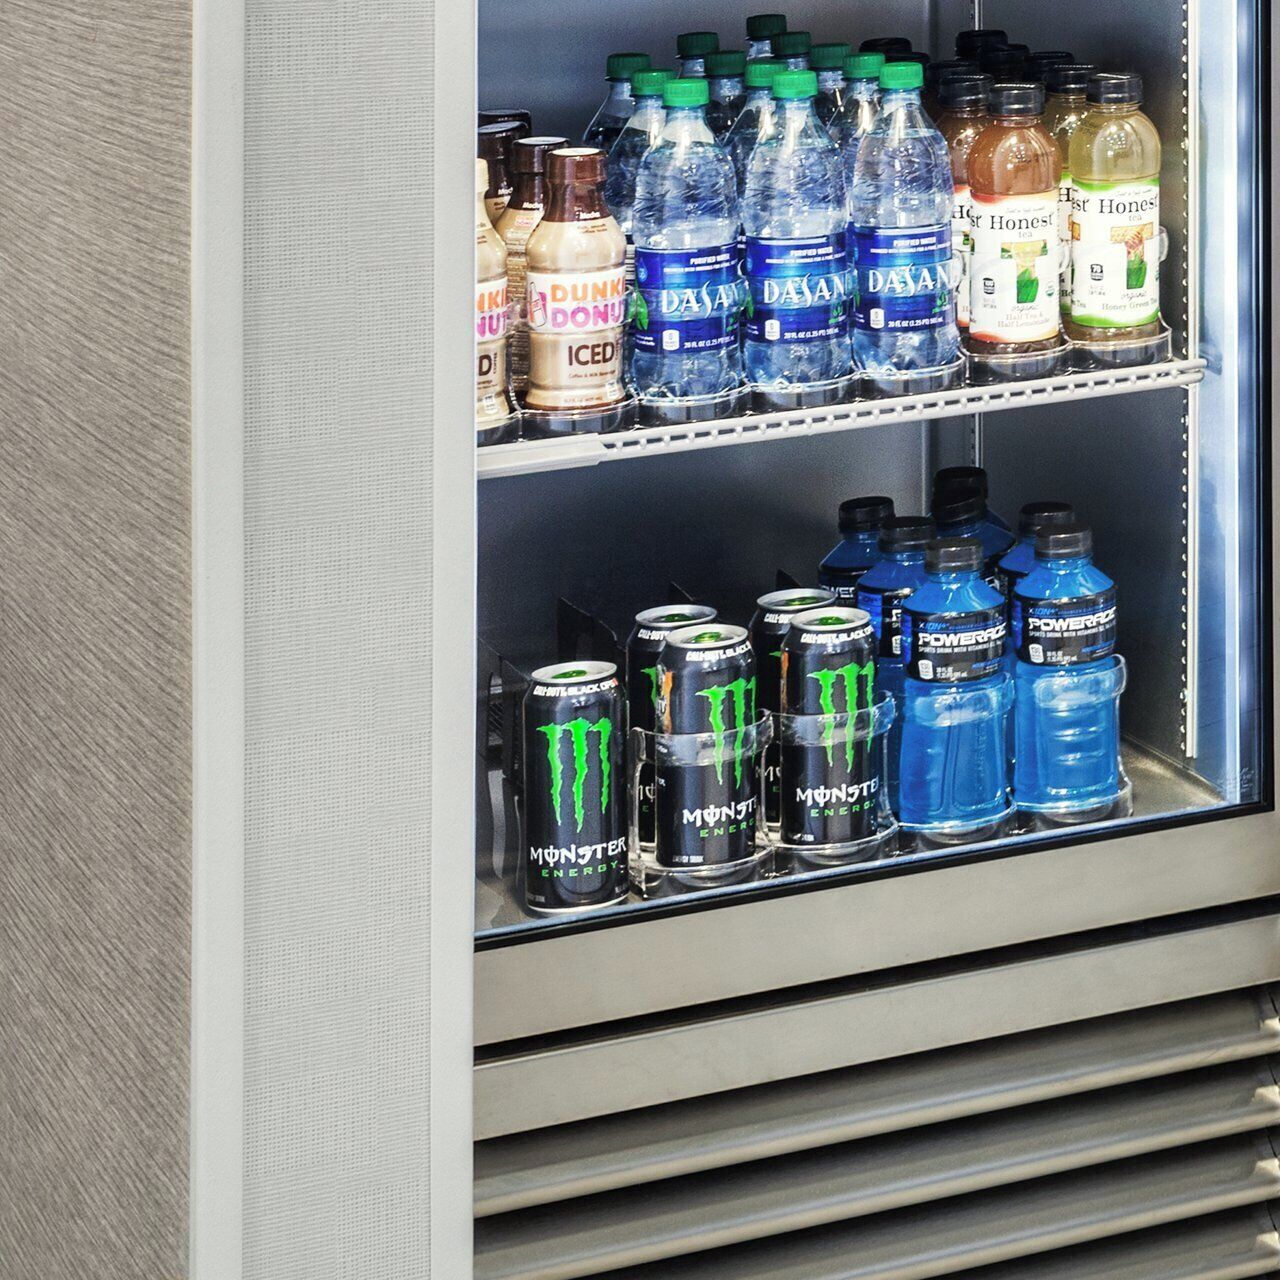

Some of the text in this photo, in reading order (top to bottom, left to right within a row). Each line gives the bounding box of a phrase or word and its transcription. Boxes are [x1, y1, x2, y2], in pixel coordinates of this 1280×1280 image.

[1100, 196, 1157, 214] Honest
[990, 215, 1053, 231] Honest
[568, 342, 615, 366] ICED
